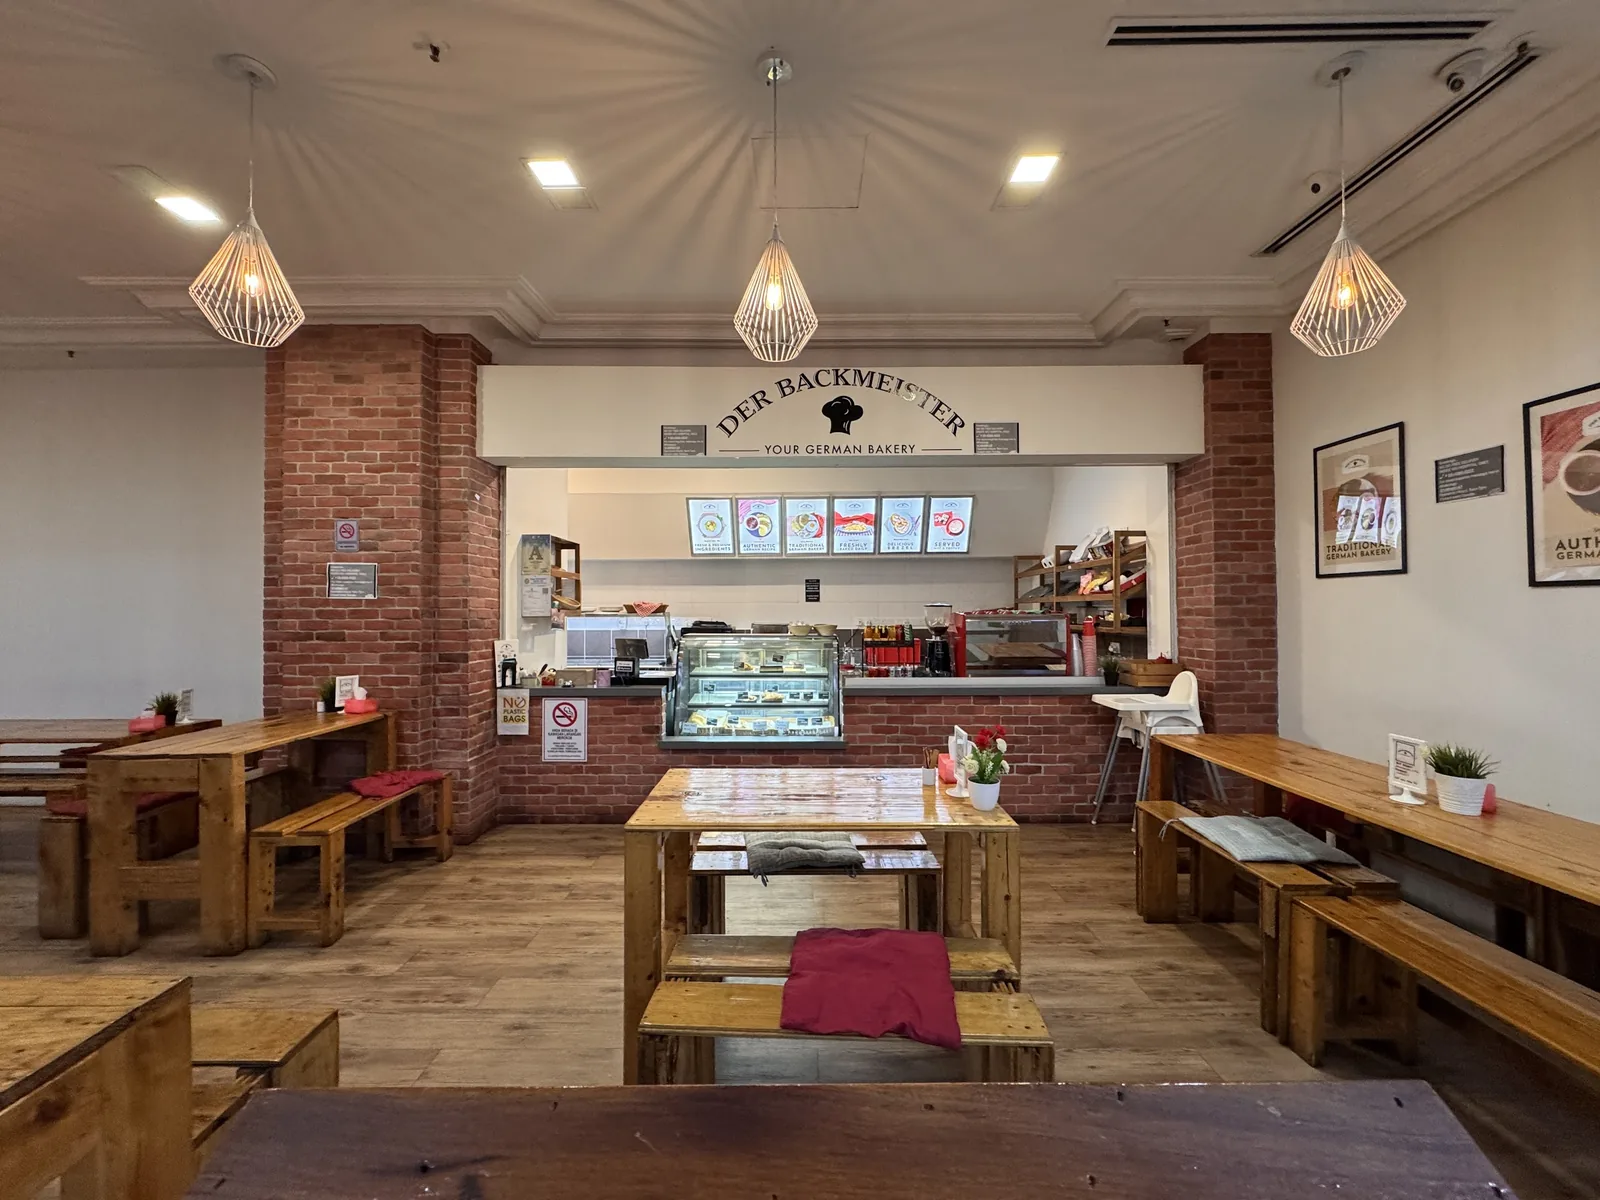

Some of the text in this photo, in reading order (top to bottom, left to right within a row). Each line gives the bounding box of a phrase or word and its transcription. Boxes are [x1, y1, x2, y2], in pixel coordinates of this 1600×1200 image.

[716, 368, 966, 438] DER BACKMEISTER
[764, 444, 916, 455] YOUR GERMAN BAKERY
[528, 545, 544, 560] A
[1326, 548, 1391, 560] GERMAN BAKERY
[503, 697, 526, 708] NO
[503, 715, 526, 723] BAGS
